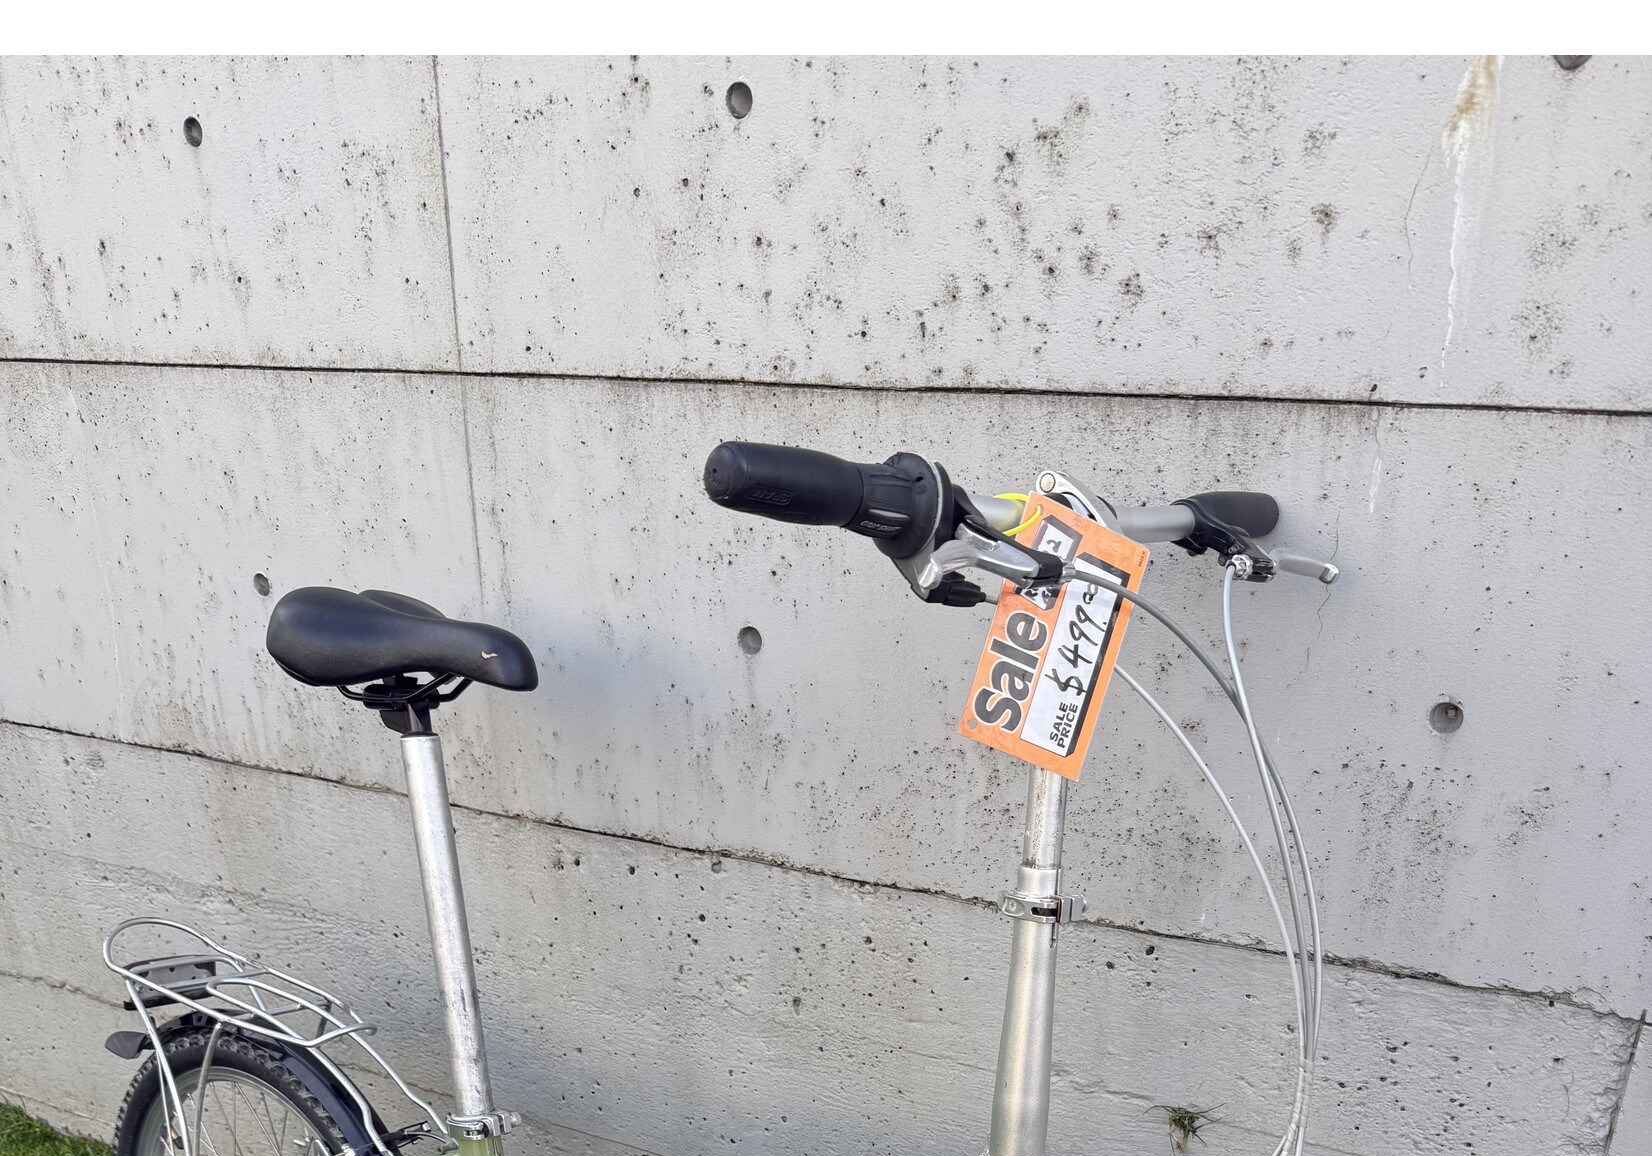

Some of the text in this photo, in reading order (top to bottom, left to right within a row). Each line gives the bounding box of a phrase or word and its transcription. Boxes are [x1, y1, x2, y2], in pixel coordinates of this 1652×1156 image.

[972, 611, 1049, 732] Sale
[1049, 702, 1069, 742] SALE
[1056, 703, 1078, 749] PRICE
